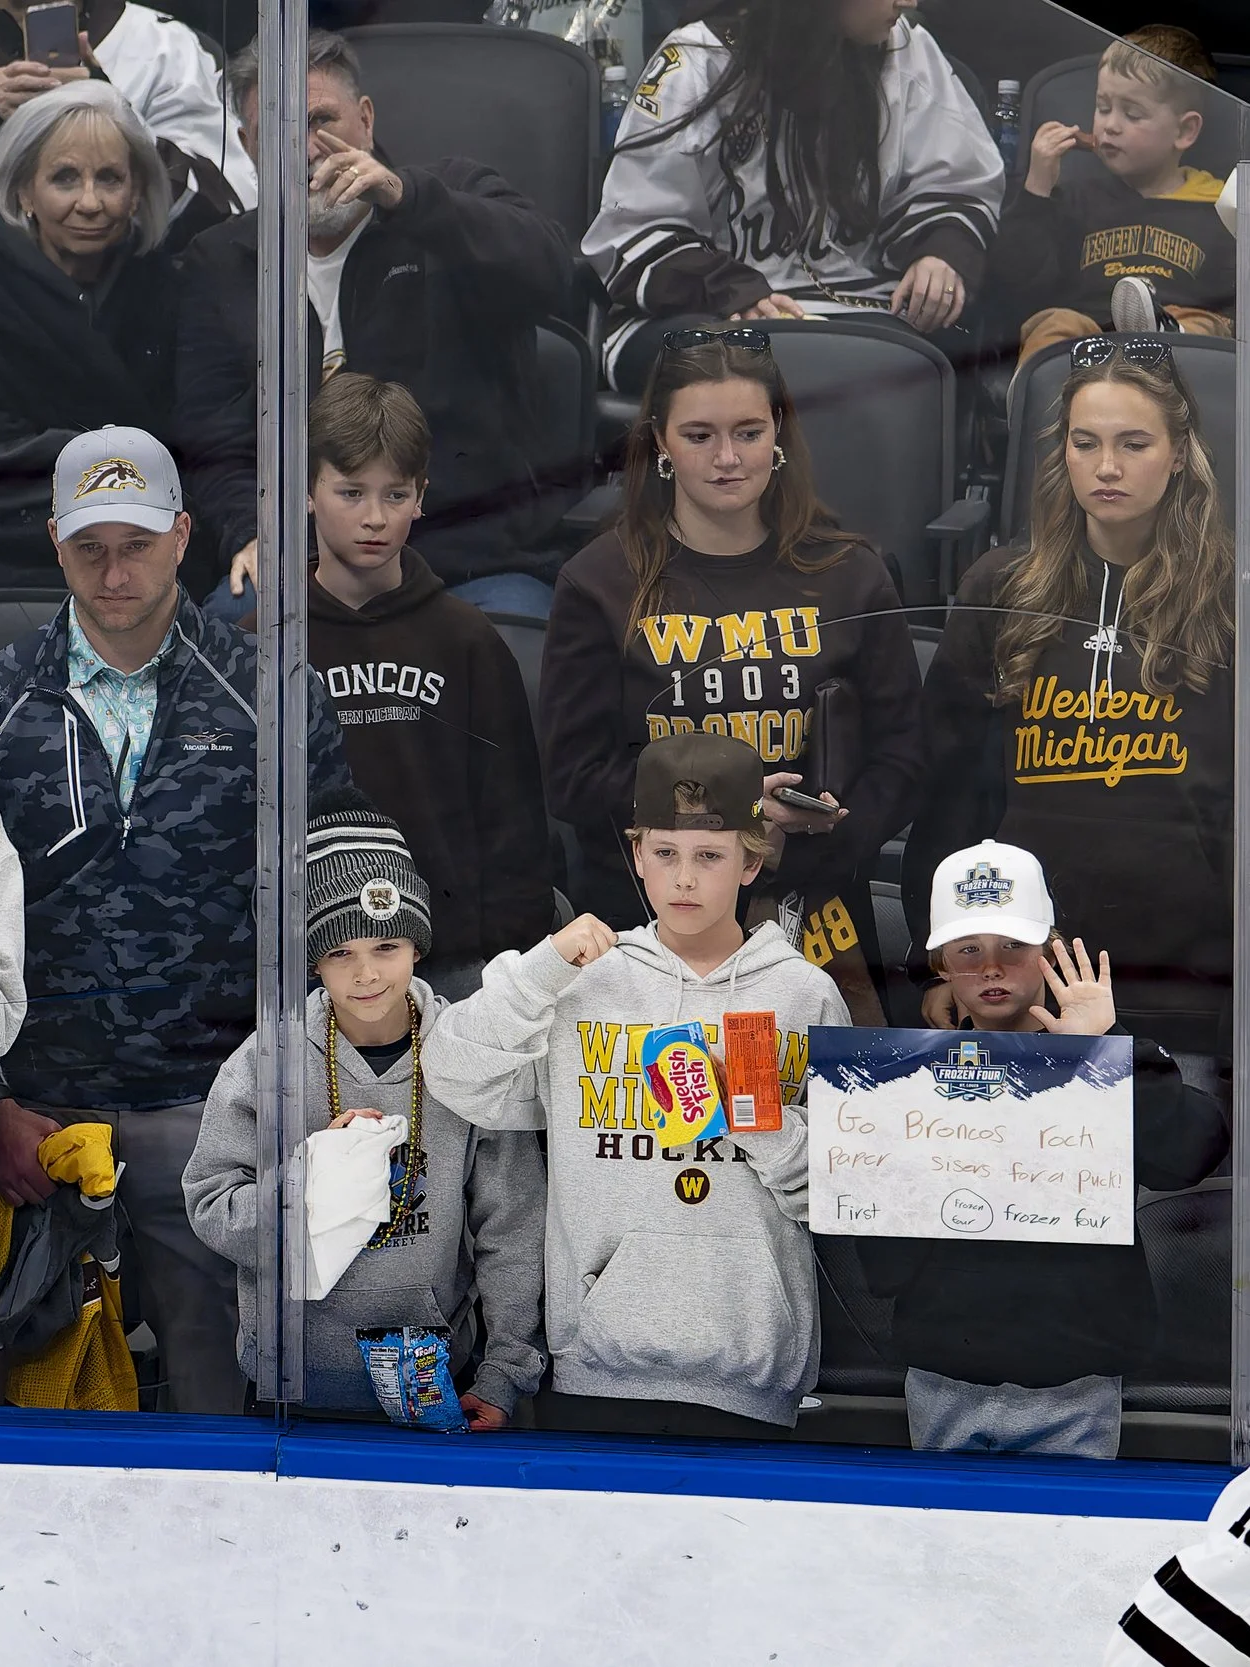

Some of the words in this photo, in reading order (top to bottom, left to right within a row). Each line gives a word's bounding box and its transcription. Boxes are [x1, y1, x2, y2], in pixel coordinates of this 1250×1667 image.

[638, 606, 822, 666] WMU
[316, 662, 446, 705] ONCOS
[1022, 675, 1183, 722] Western
[1015, 725, 1188, 787] Michigan
[668, 1048, 705, 1123] Swedish
[687, 1060, 712, 1103] Fish
[939, 1068, 975, 1080] FROZEN
[976, 1070, 1002, 1081] FOUR
[837, 1101, 876, 1134] Go
[905, 1110, 1007, 1144] Broncos
[680, 1176, 705, 1198] W
[1008, 1162, 1047, 1183] for
[1050, 1172, 1064, 1183] a
[837, 1194, 881, 1221] First
